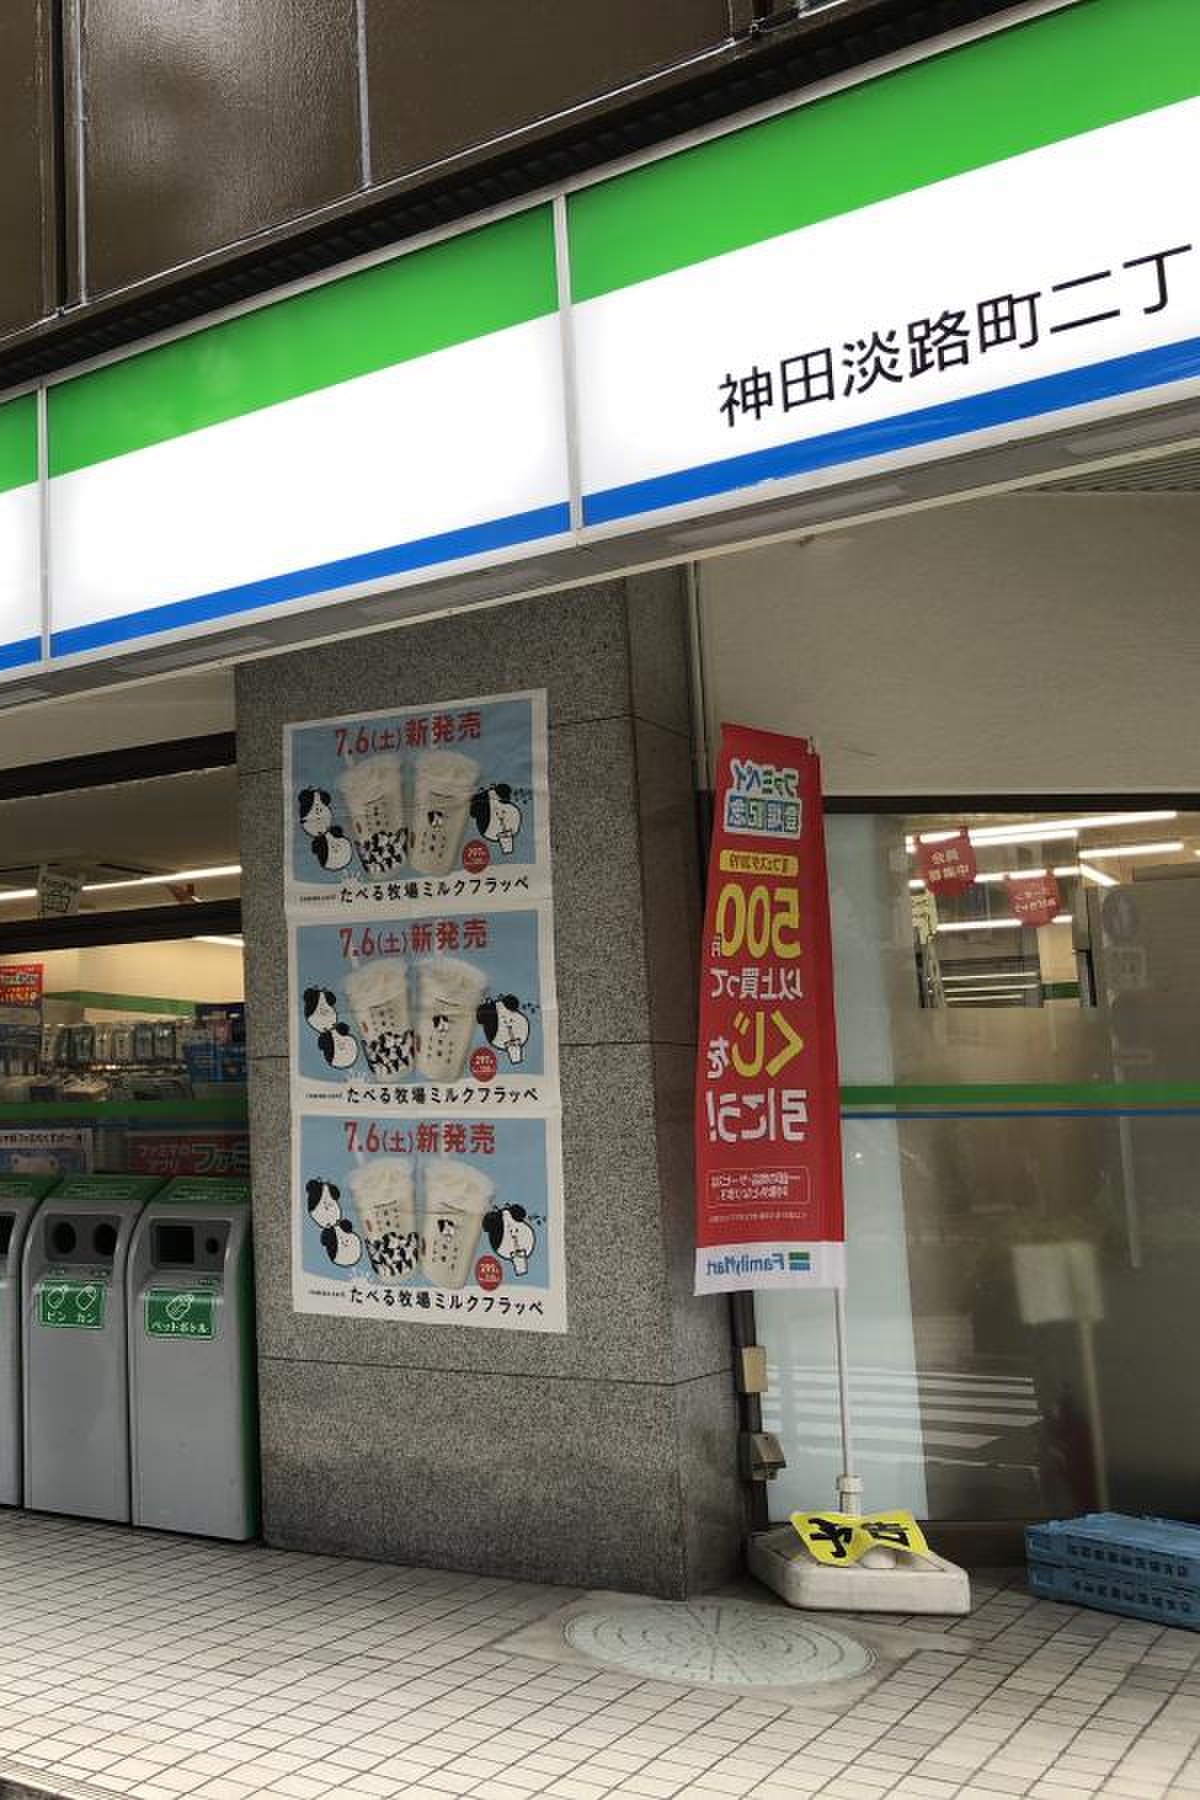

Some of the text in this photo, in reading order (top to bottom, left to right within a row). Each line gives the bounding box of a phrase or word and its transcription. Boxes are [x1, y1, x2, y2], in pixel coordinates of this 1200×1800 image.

[717, 243, 1193, 428] 神田淡路町二丁
[350, 1288, 544, 1315] たべる牧場ミルクフラッペ
